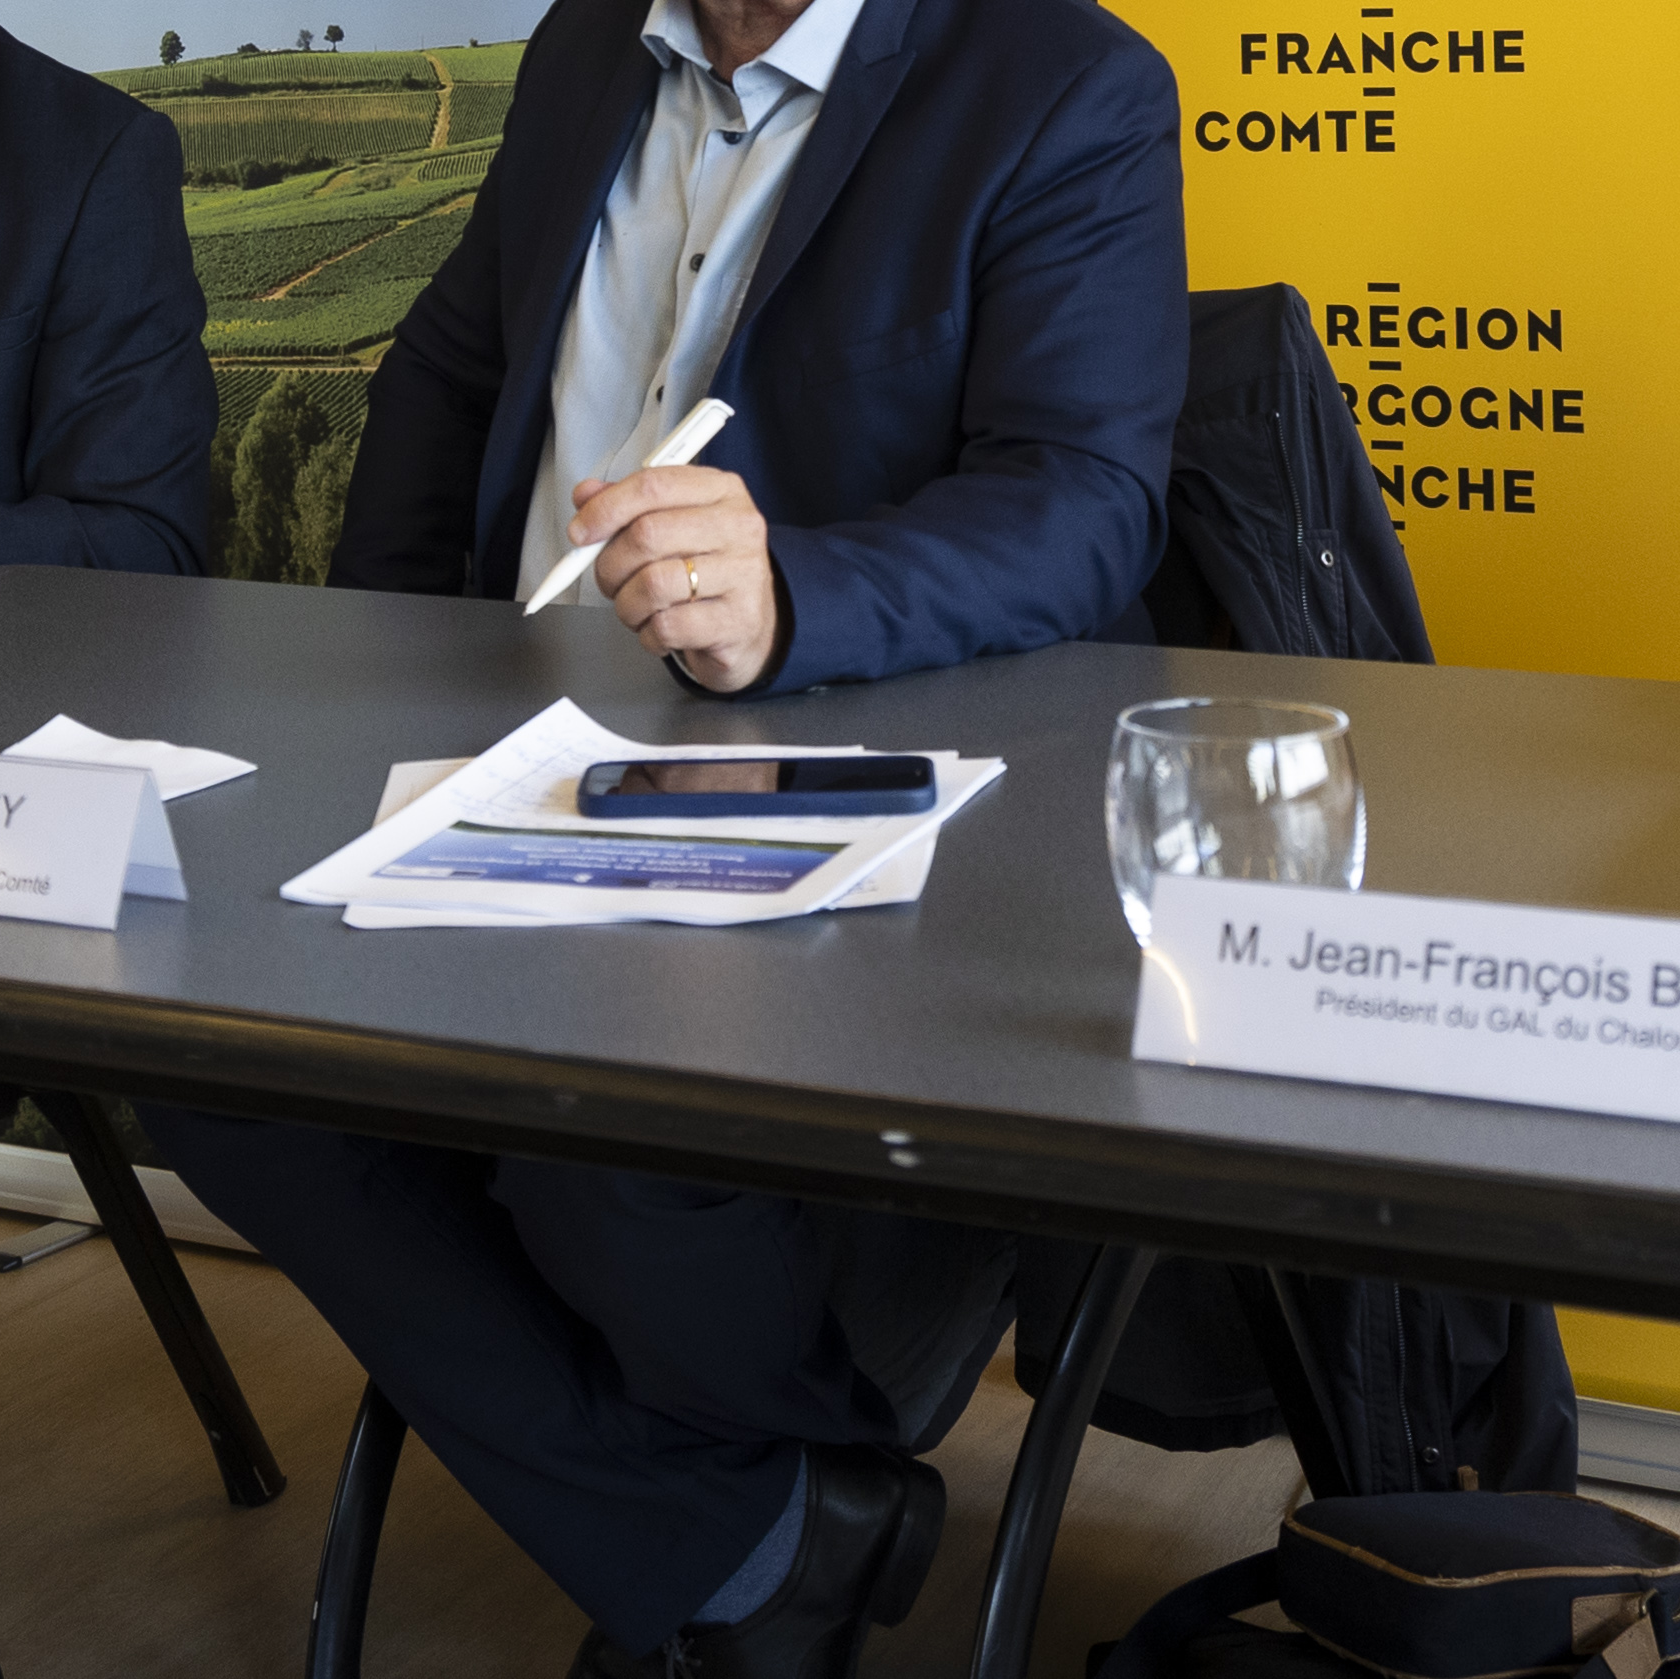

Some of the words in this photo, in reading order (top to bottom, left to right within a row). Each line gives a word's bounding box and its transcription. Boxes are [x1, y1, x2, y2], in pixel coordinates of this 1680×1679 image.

[1240, 30, 1525, 74] FRANCHE
[1219, 922, 1271, 967] M.
[1287, 928, 1631, 1004] Jean-François
[1315, 987, 1437, 1027] Président
[1446, 1002, 1481, 1030] du
[1553, 1016, 1591, 1043] du
